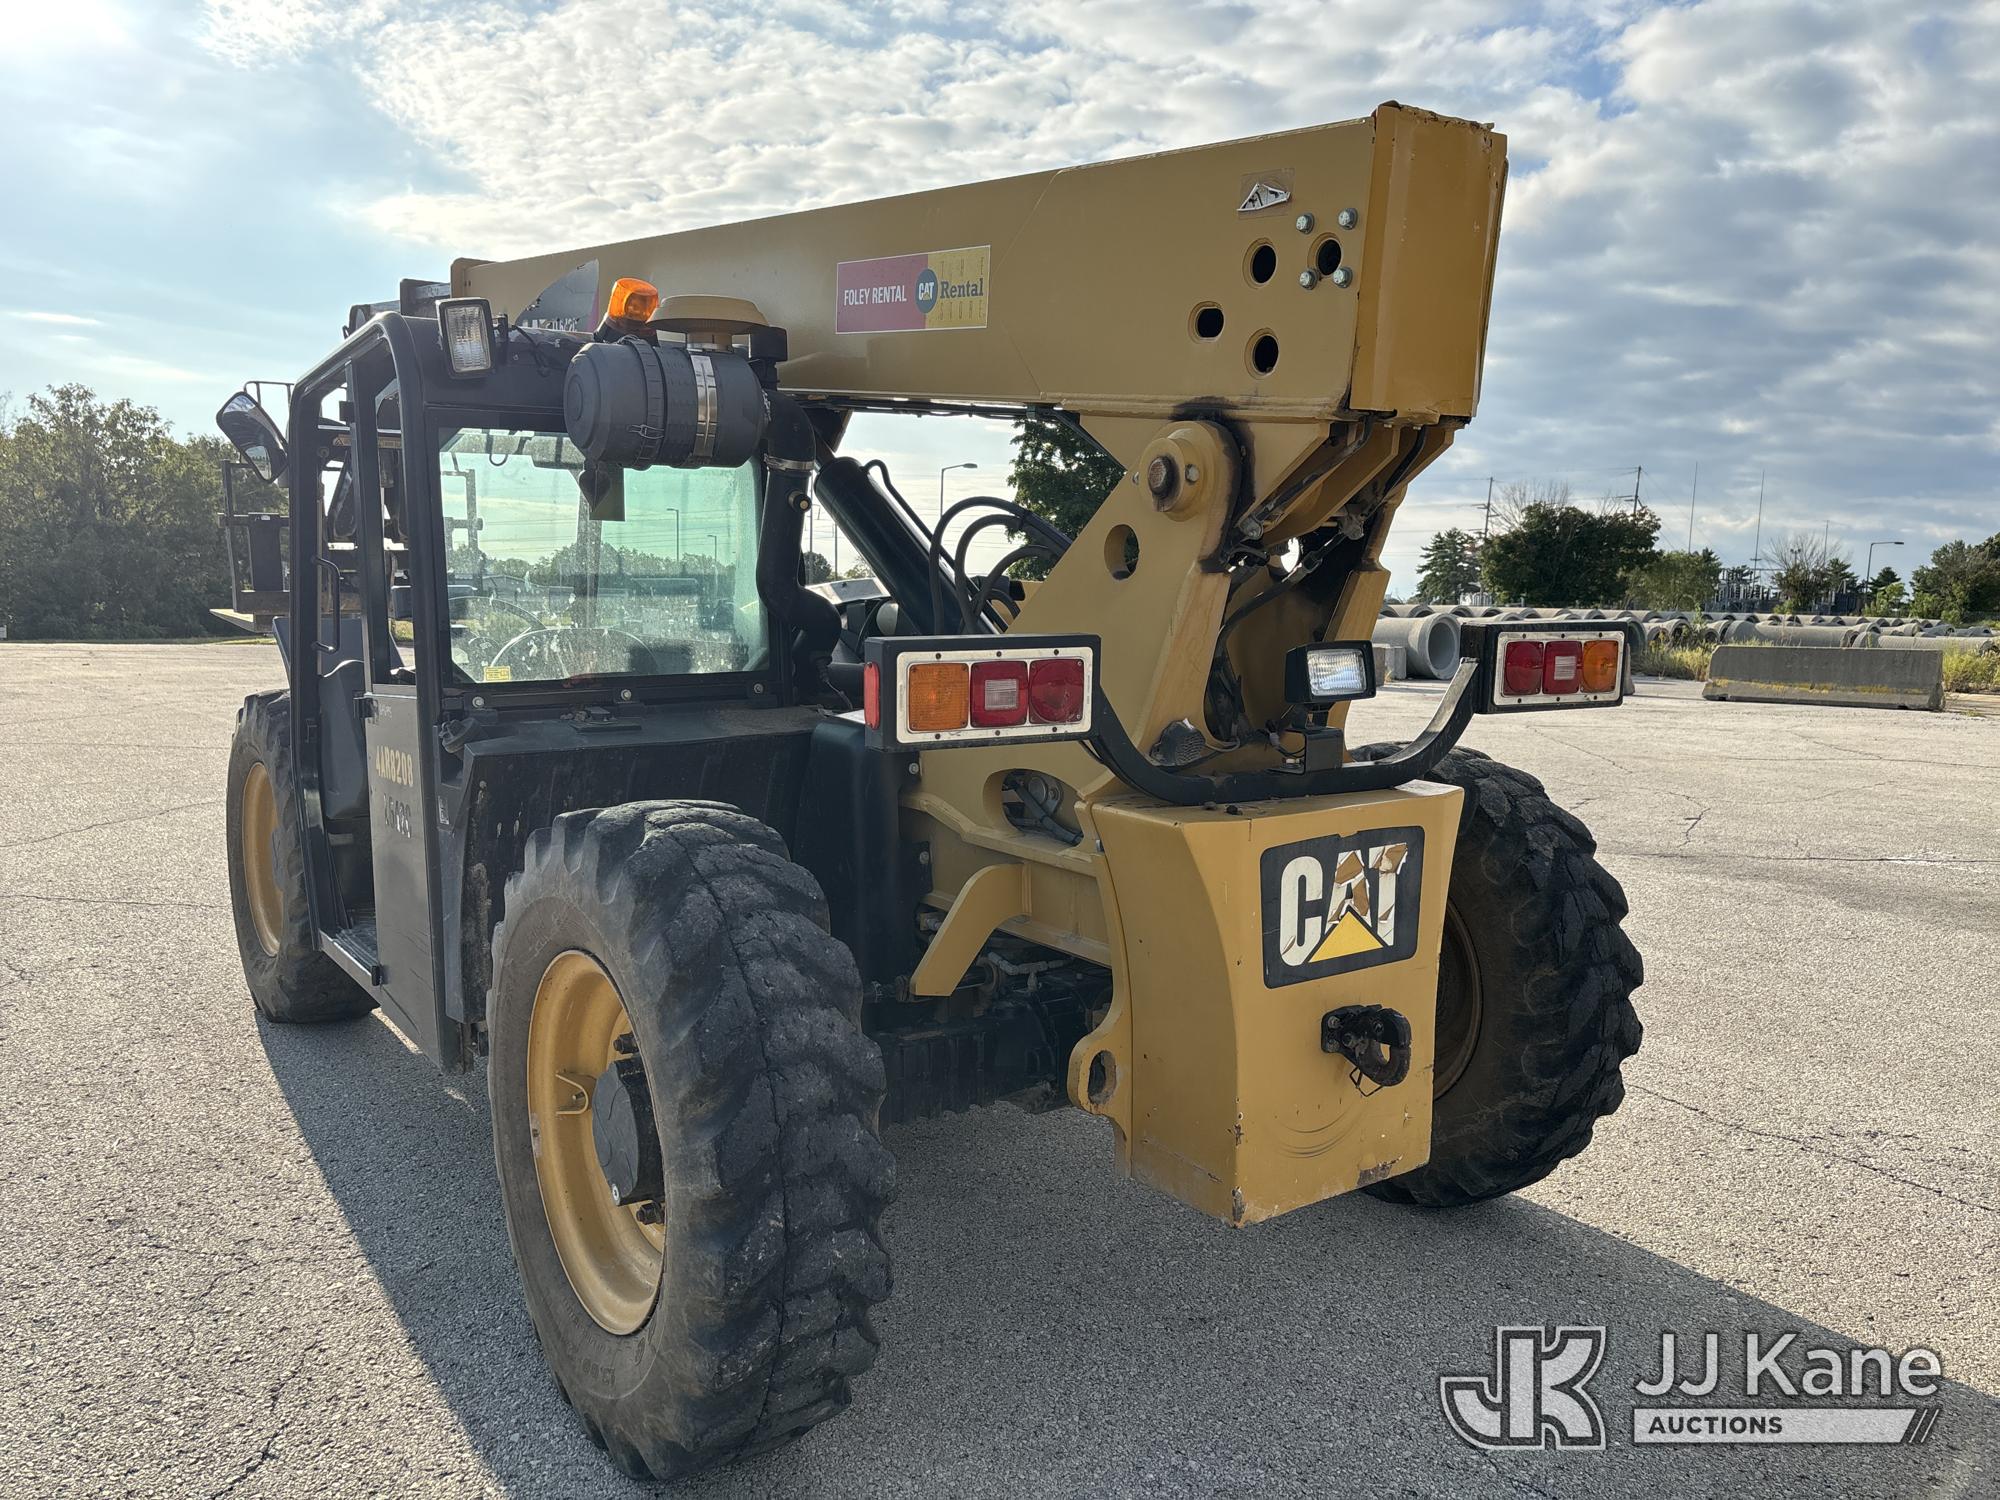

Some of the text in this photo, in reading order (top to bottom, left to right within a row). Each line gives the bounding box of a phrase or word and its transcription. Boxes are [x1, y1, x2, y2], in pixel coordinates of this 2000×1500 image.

[843, 284, 908, 307] FOLEY RENTAL
[918, 277, 984, 301] CAT Rental
[1279, 842, 1409, 967] CAT
